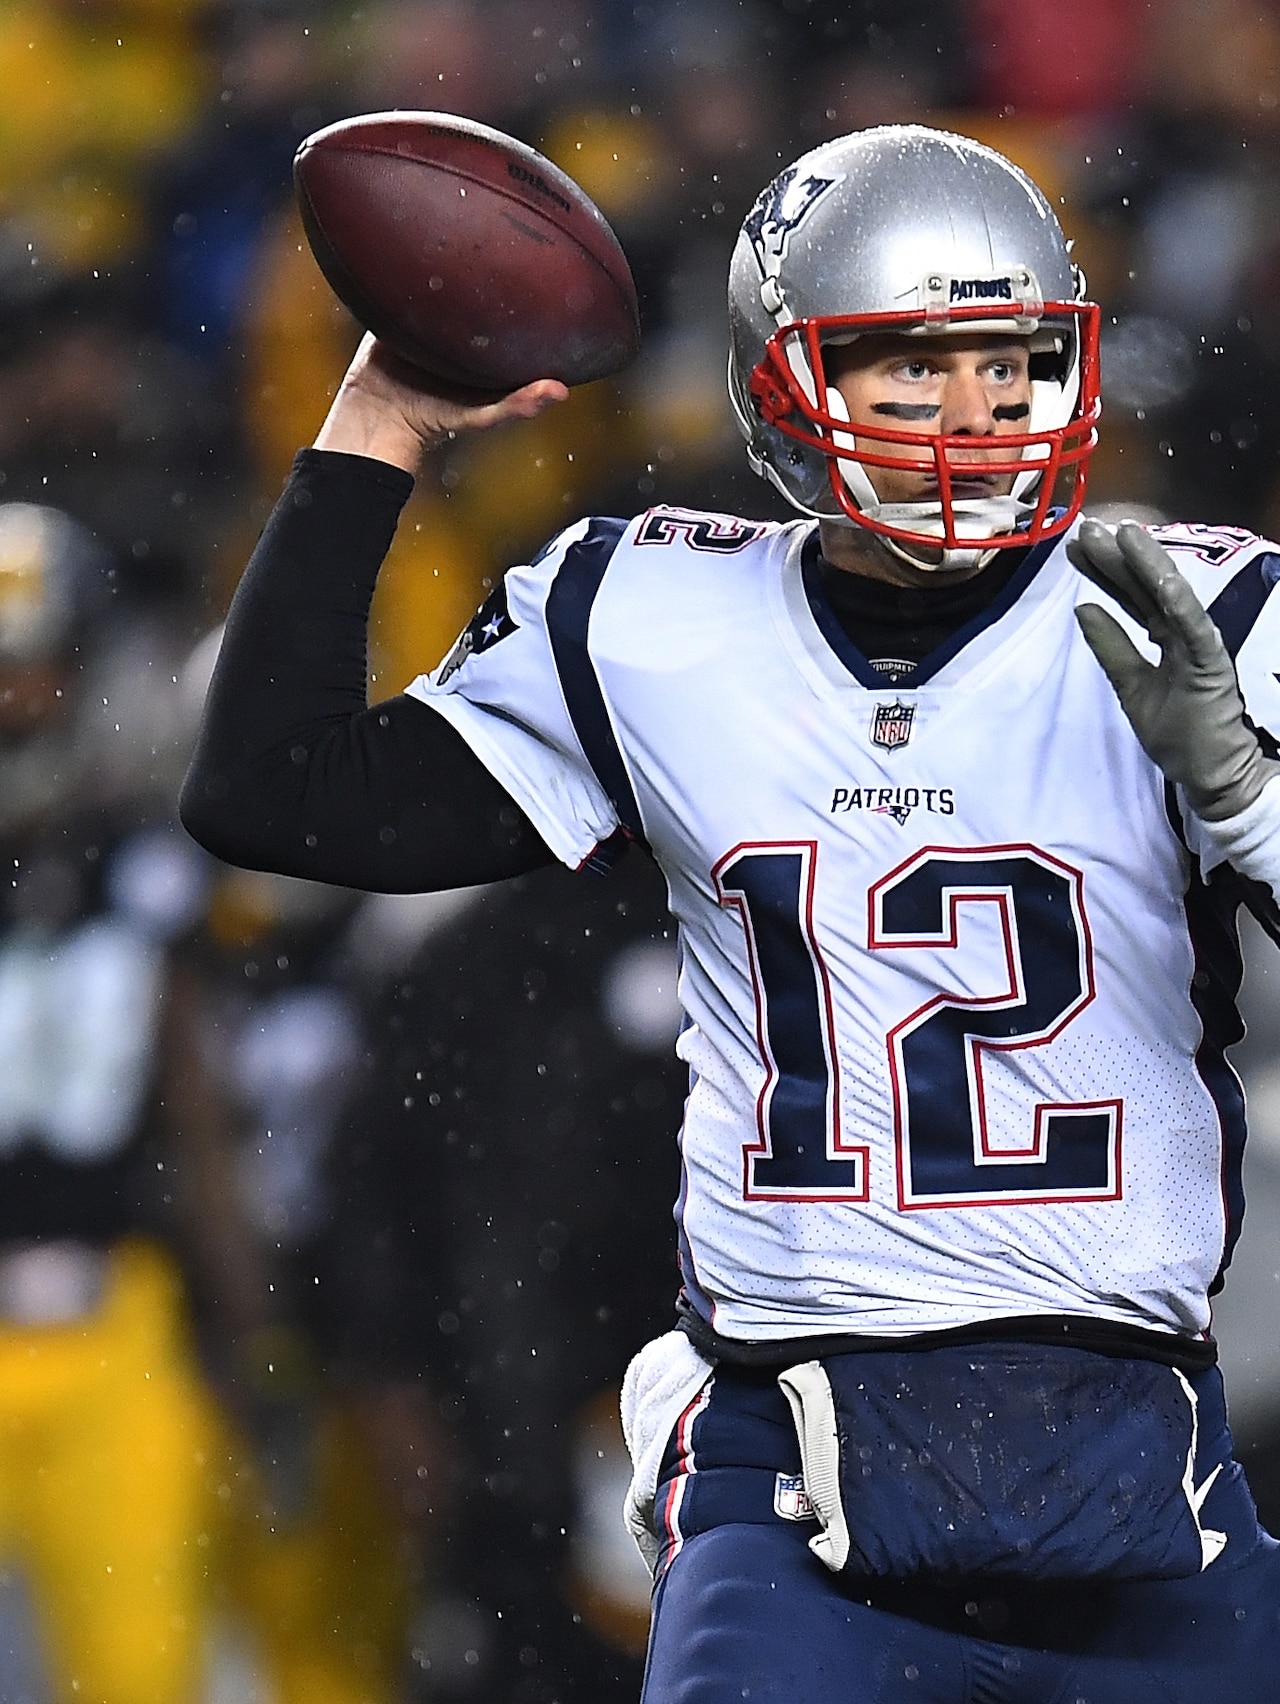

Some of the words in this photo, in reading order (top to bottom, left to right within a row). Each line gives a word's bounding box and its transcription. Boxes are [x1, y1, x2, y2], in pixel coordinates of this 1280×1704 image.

[949, 277, 1012, 303] PATRIOTS
[877, 720, 908, 744] NFL
[831, 787, 955, 815] PATRIOTS
[710, 840, 1124, 1212] 12
